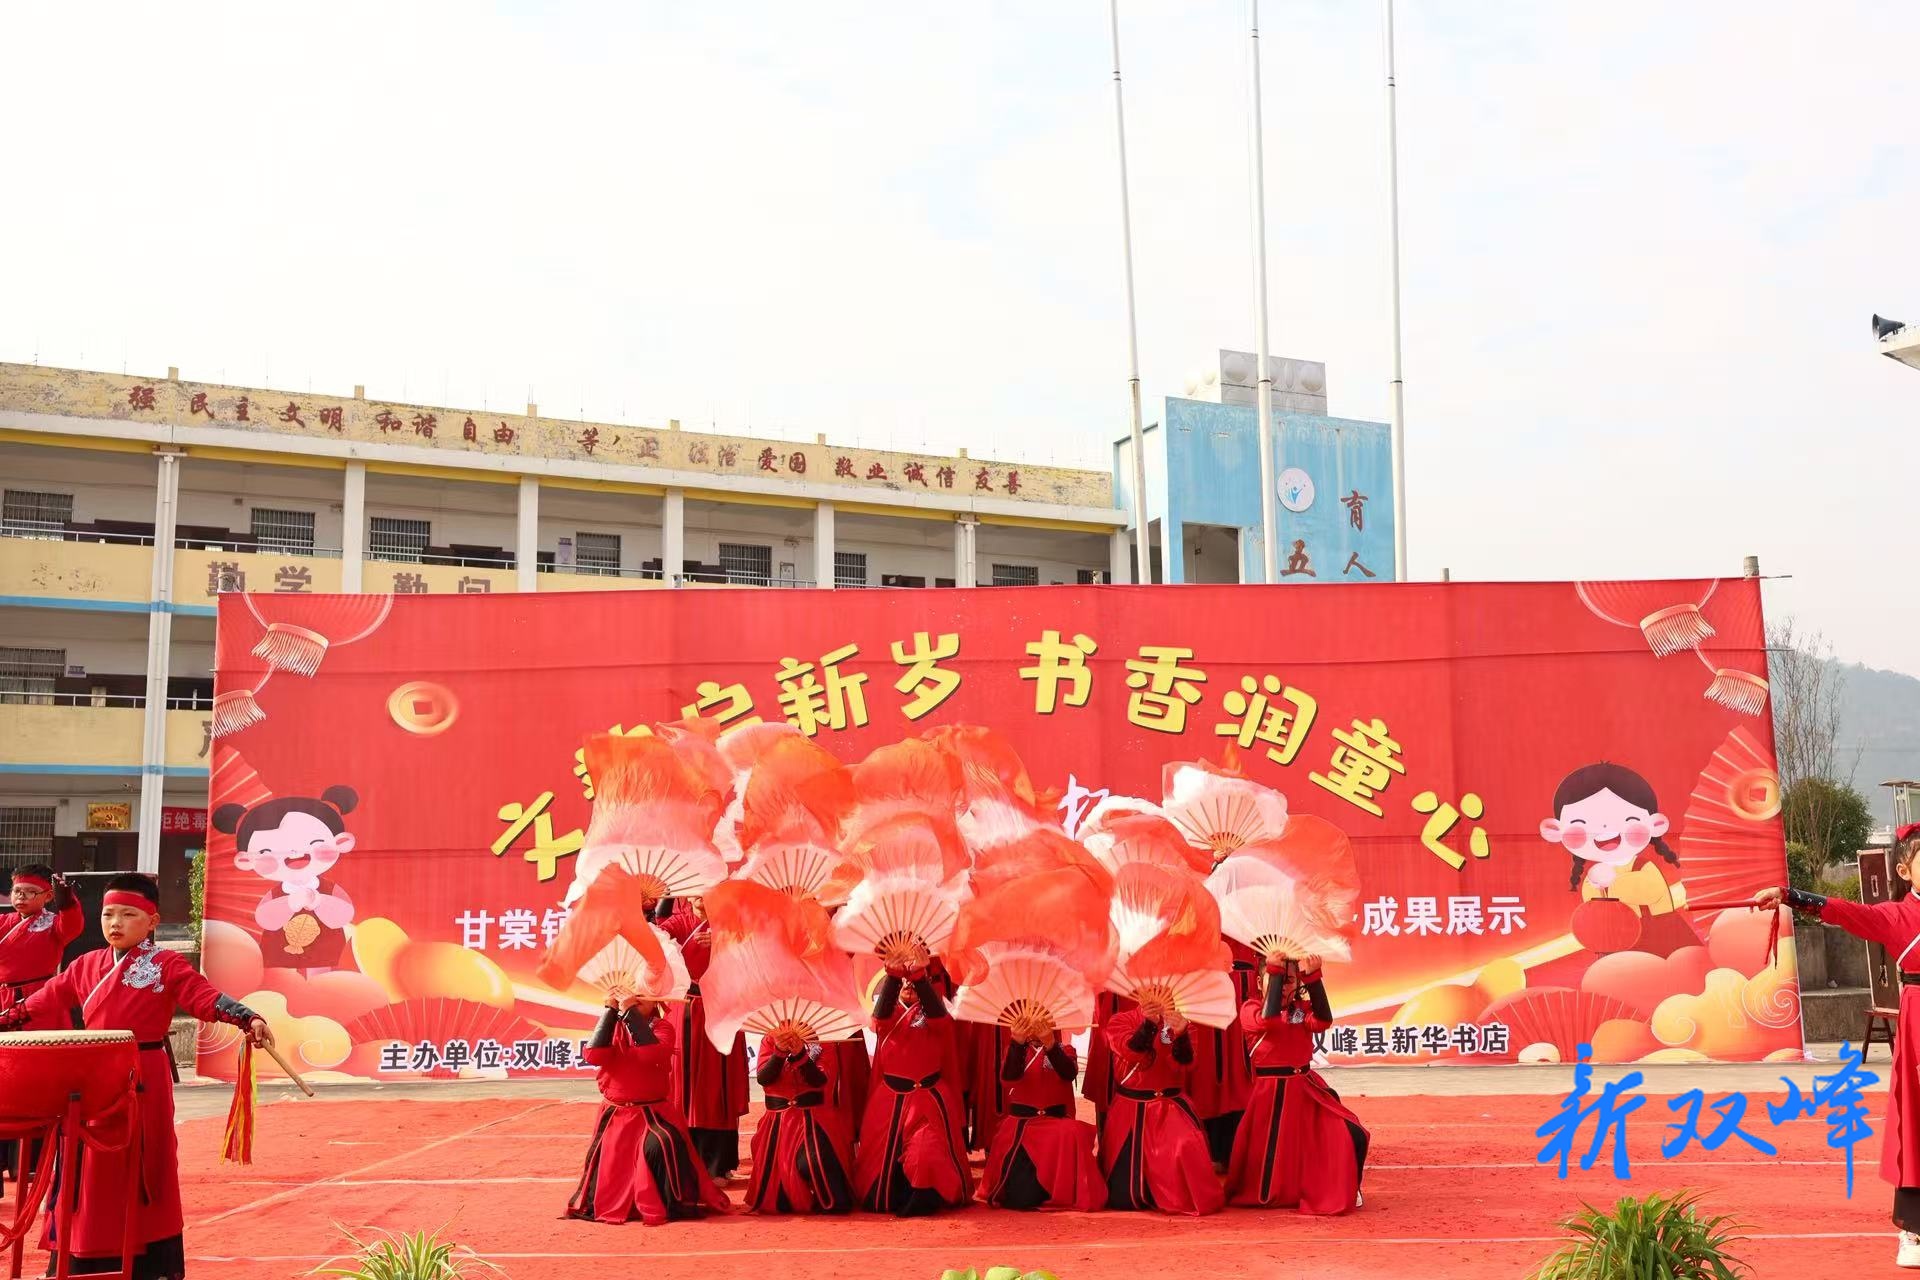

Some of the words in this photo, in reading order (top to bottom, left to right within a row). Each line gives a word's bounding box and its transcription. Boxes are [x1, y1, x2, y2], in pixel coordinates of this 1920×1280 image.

[190, 392, 250, 421] 民主
[278, 401, 343, 432] 文明
[375, 409, 438, 439] 和谐
[462, 417, 515, 445] 自由
[757, 446, 807, 474] 爱国
[835, 456, 888, 481] 敬业
[903, 462, 956, 489] 诚信
[975, 467, 1023, 495] 友善
[489, 630, 963, 882] 文启新岁
[1018, 629, 1491, 873] 书香润童心
[1360, 895, 1528, 937] 成果展示
